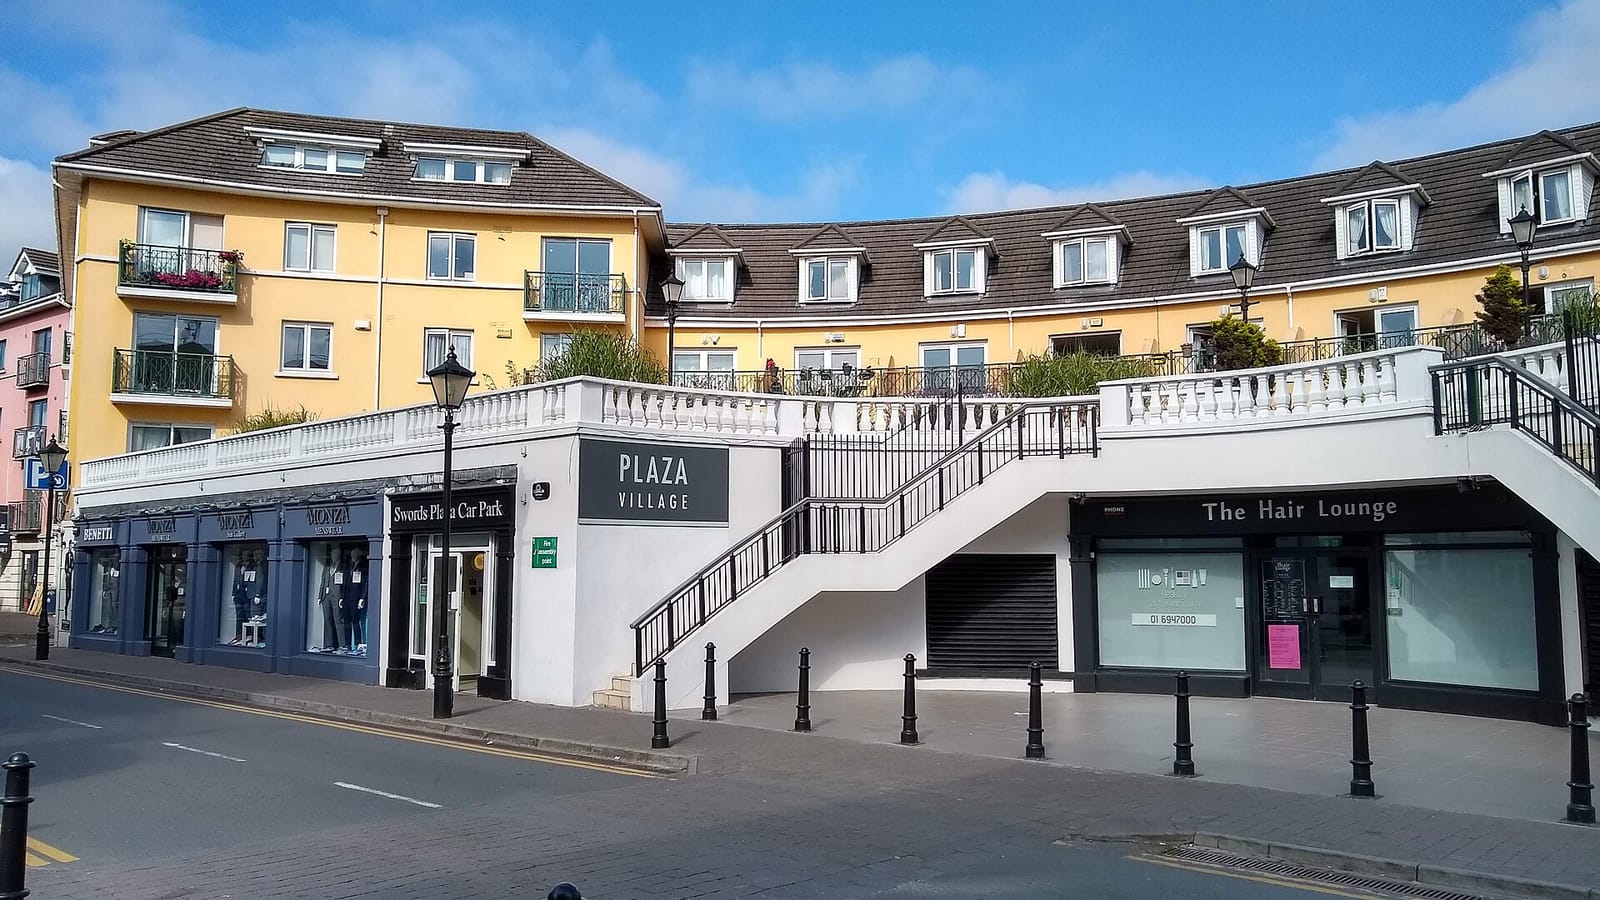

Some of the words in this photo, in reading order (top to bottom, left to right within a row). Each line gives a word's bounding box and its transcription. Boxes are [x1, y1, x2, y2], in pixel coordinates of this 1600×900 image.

[619, 453, 689, 485] PLAZA
[618, 491, 689, 510] VILLAGE
[307, 506, 351, 525] MONZA
[393, 505, 428, 522] Swords
[430, 503, 456, 520] Plza
[458, 502, 478, 519] Car
[479, 500, 503, 518] Park
[1201, 501, 1246, 521] The
[1258, 499, 1305, 519] Hair
[1318, 499, 1398, 522] Lounge
[217, 512, 255, 530] MONZA
[83, 527, 113, 542] BENETTI
[1150, 614, 1159, 624] 01
[1161, 614, 1197, 625] 6947000
